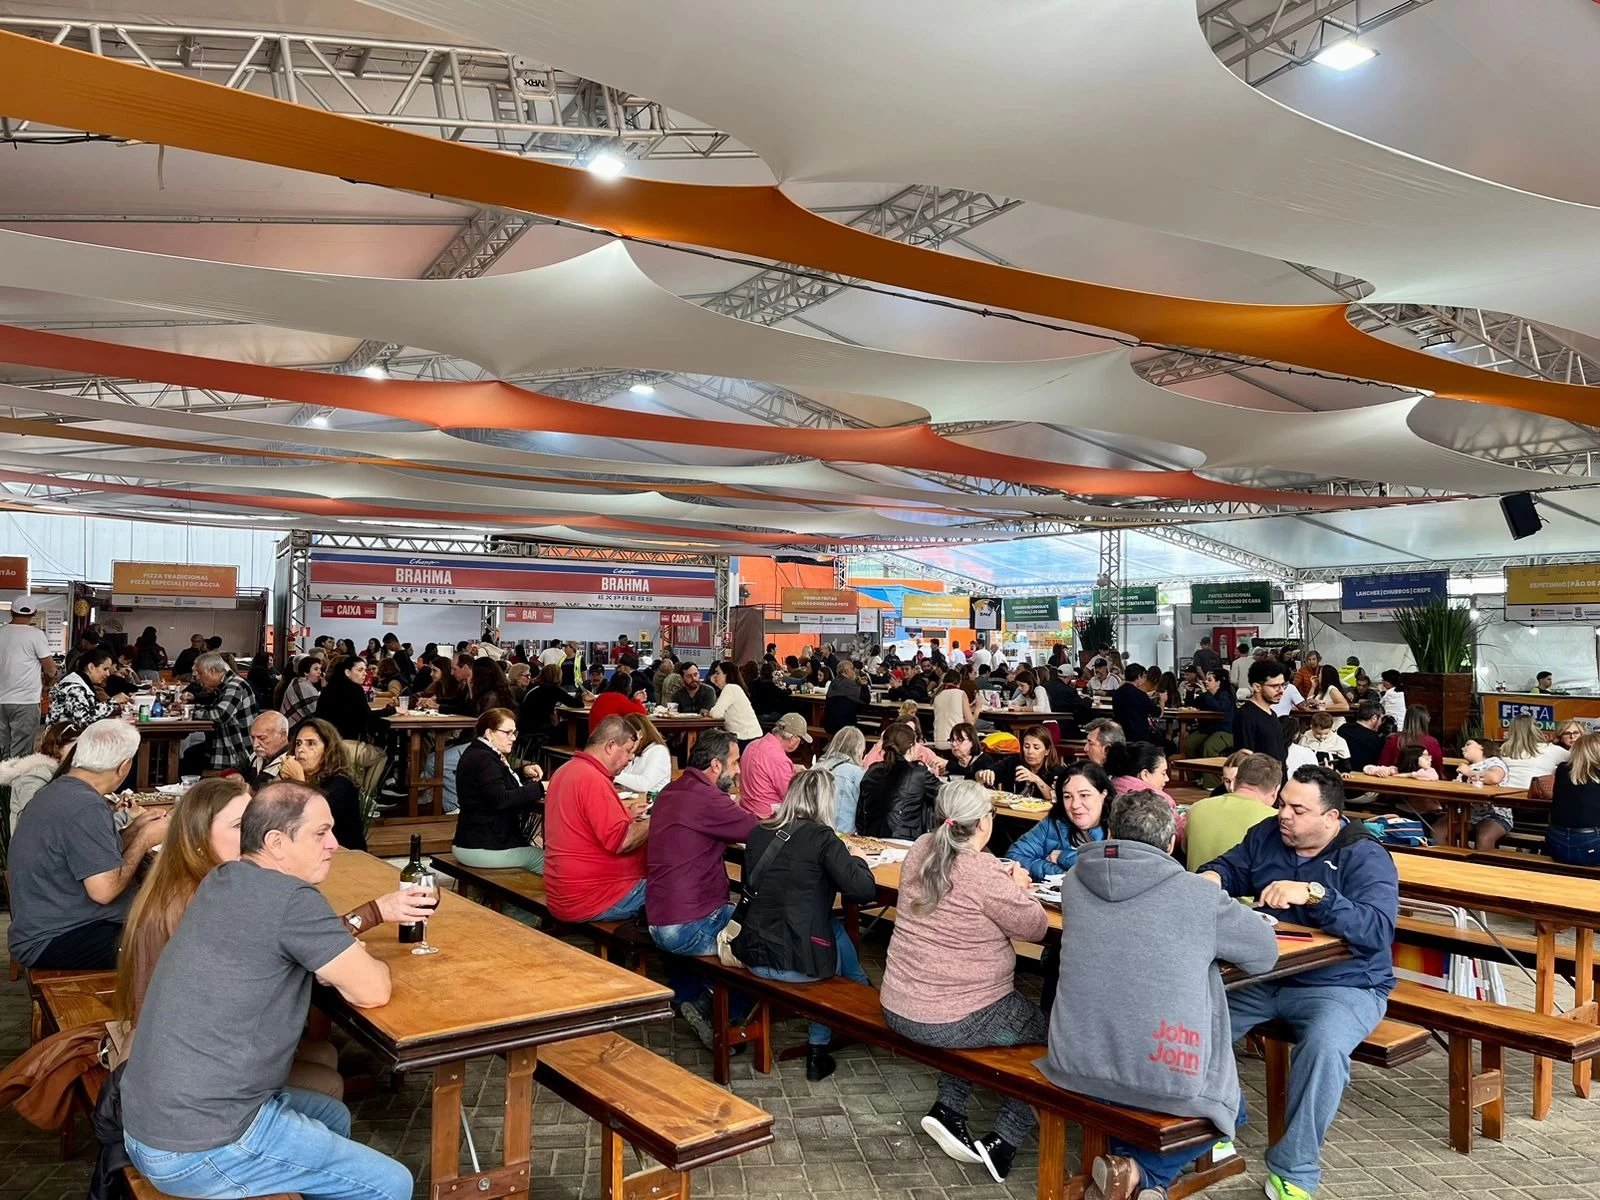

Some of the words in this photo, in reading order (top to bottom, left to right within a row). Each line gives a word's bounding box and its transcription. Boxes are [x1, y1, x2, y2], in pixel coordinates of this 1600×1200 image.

[164, 573, 209, 581] TRADICIONAL
[395, 568, 452, 585] BRAHMA
[601, 577, 650, 593] BRAHMA
[391, 587, 457, 596] EXPRESS
[597, 594, 653, 602] EXPRESS
[337, 604, 361, 616] CAIXA
[522, 609, 537, 620] BAR
[671, 613, 691, 624] CAIXA
[1502, 704, 1550, 720] FESTA
[1152, 1018, 1200, 1047] John
[1148, 1042, 1200, 1070] John
